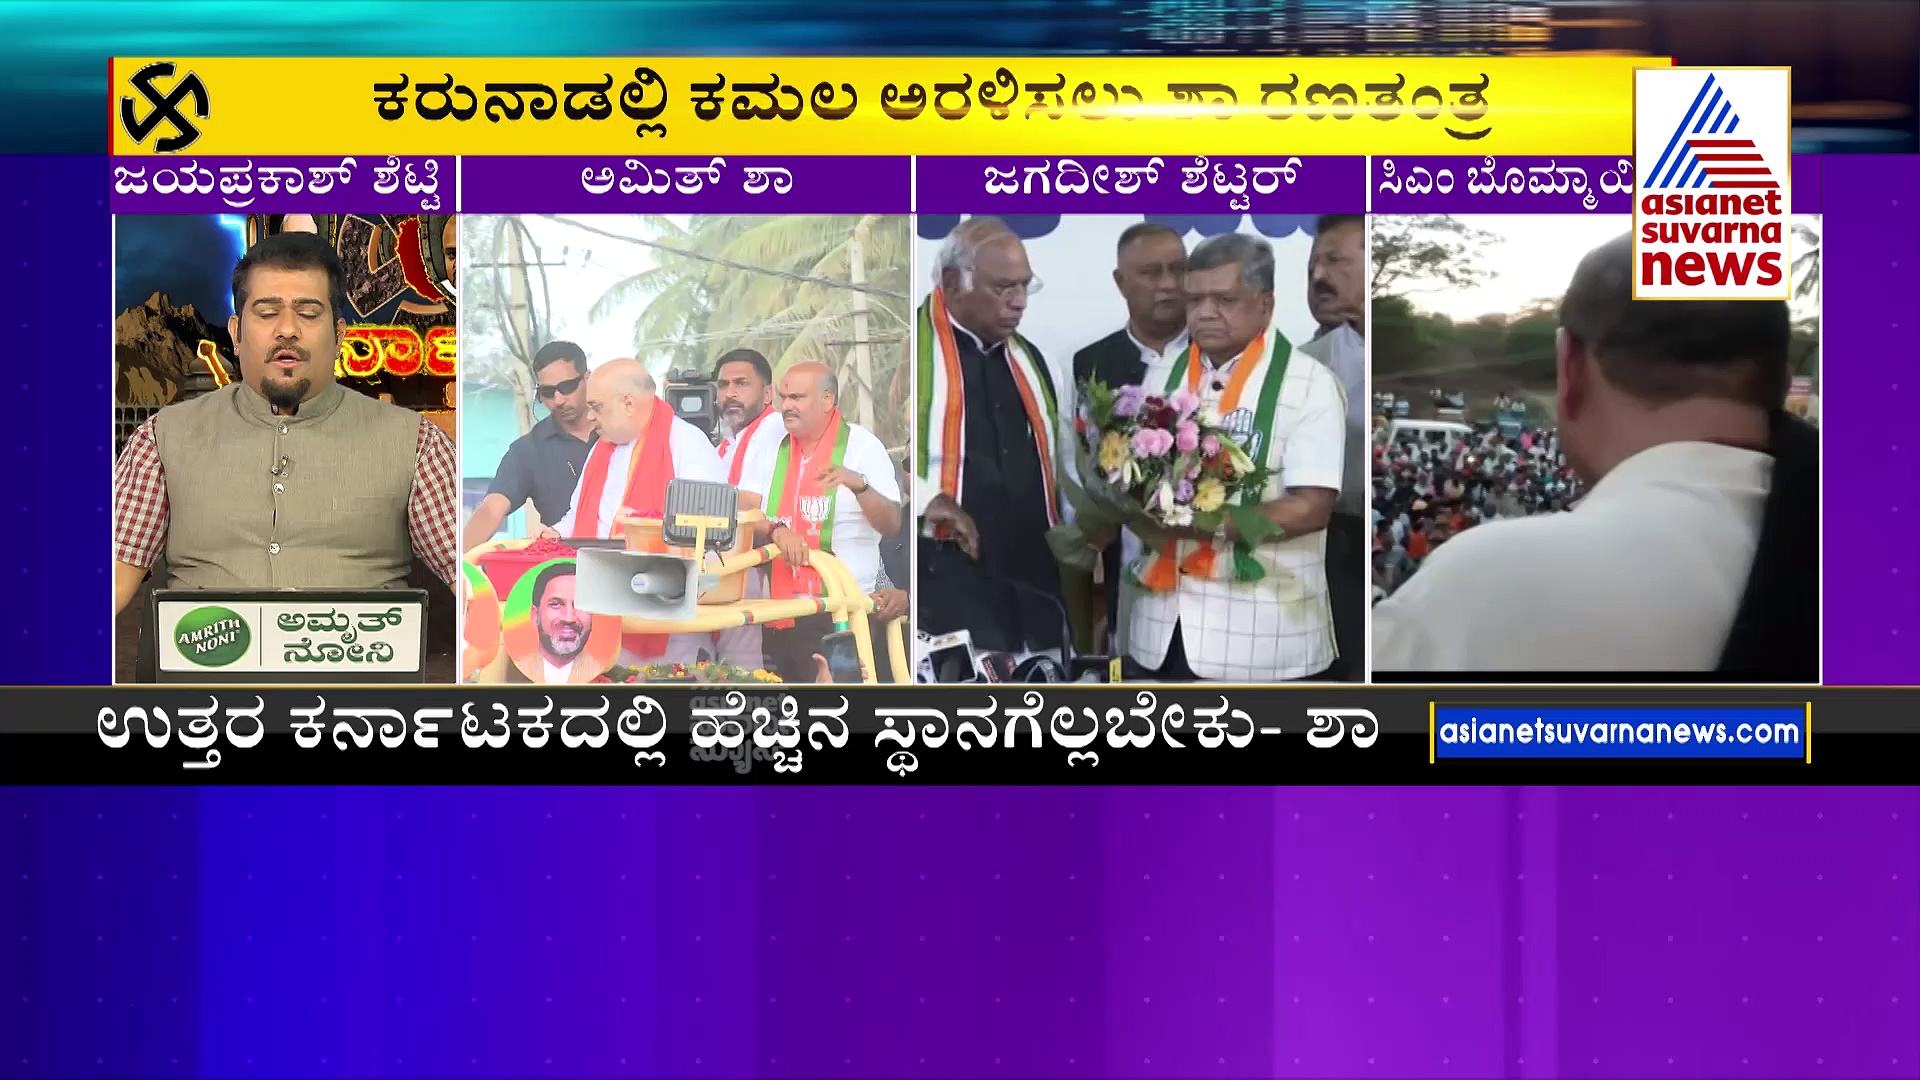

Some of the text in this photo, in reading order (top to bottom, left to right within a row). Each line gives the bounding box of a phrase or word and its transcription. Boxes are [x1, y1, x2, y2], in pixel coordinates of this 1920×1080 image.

[178, 619, 241, 644] AMRITH
[277, 606, 402, 644] ಅಮೃತ್
[195, 631, 236, 654] NONI
[283, 637, 394, 663] ನೋನಿ
